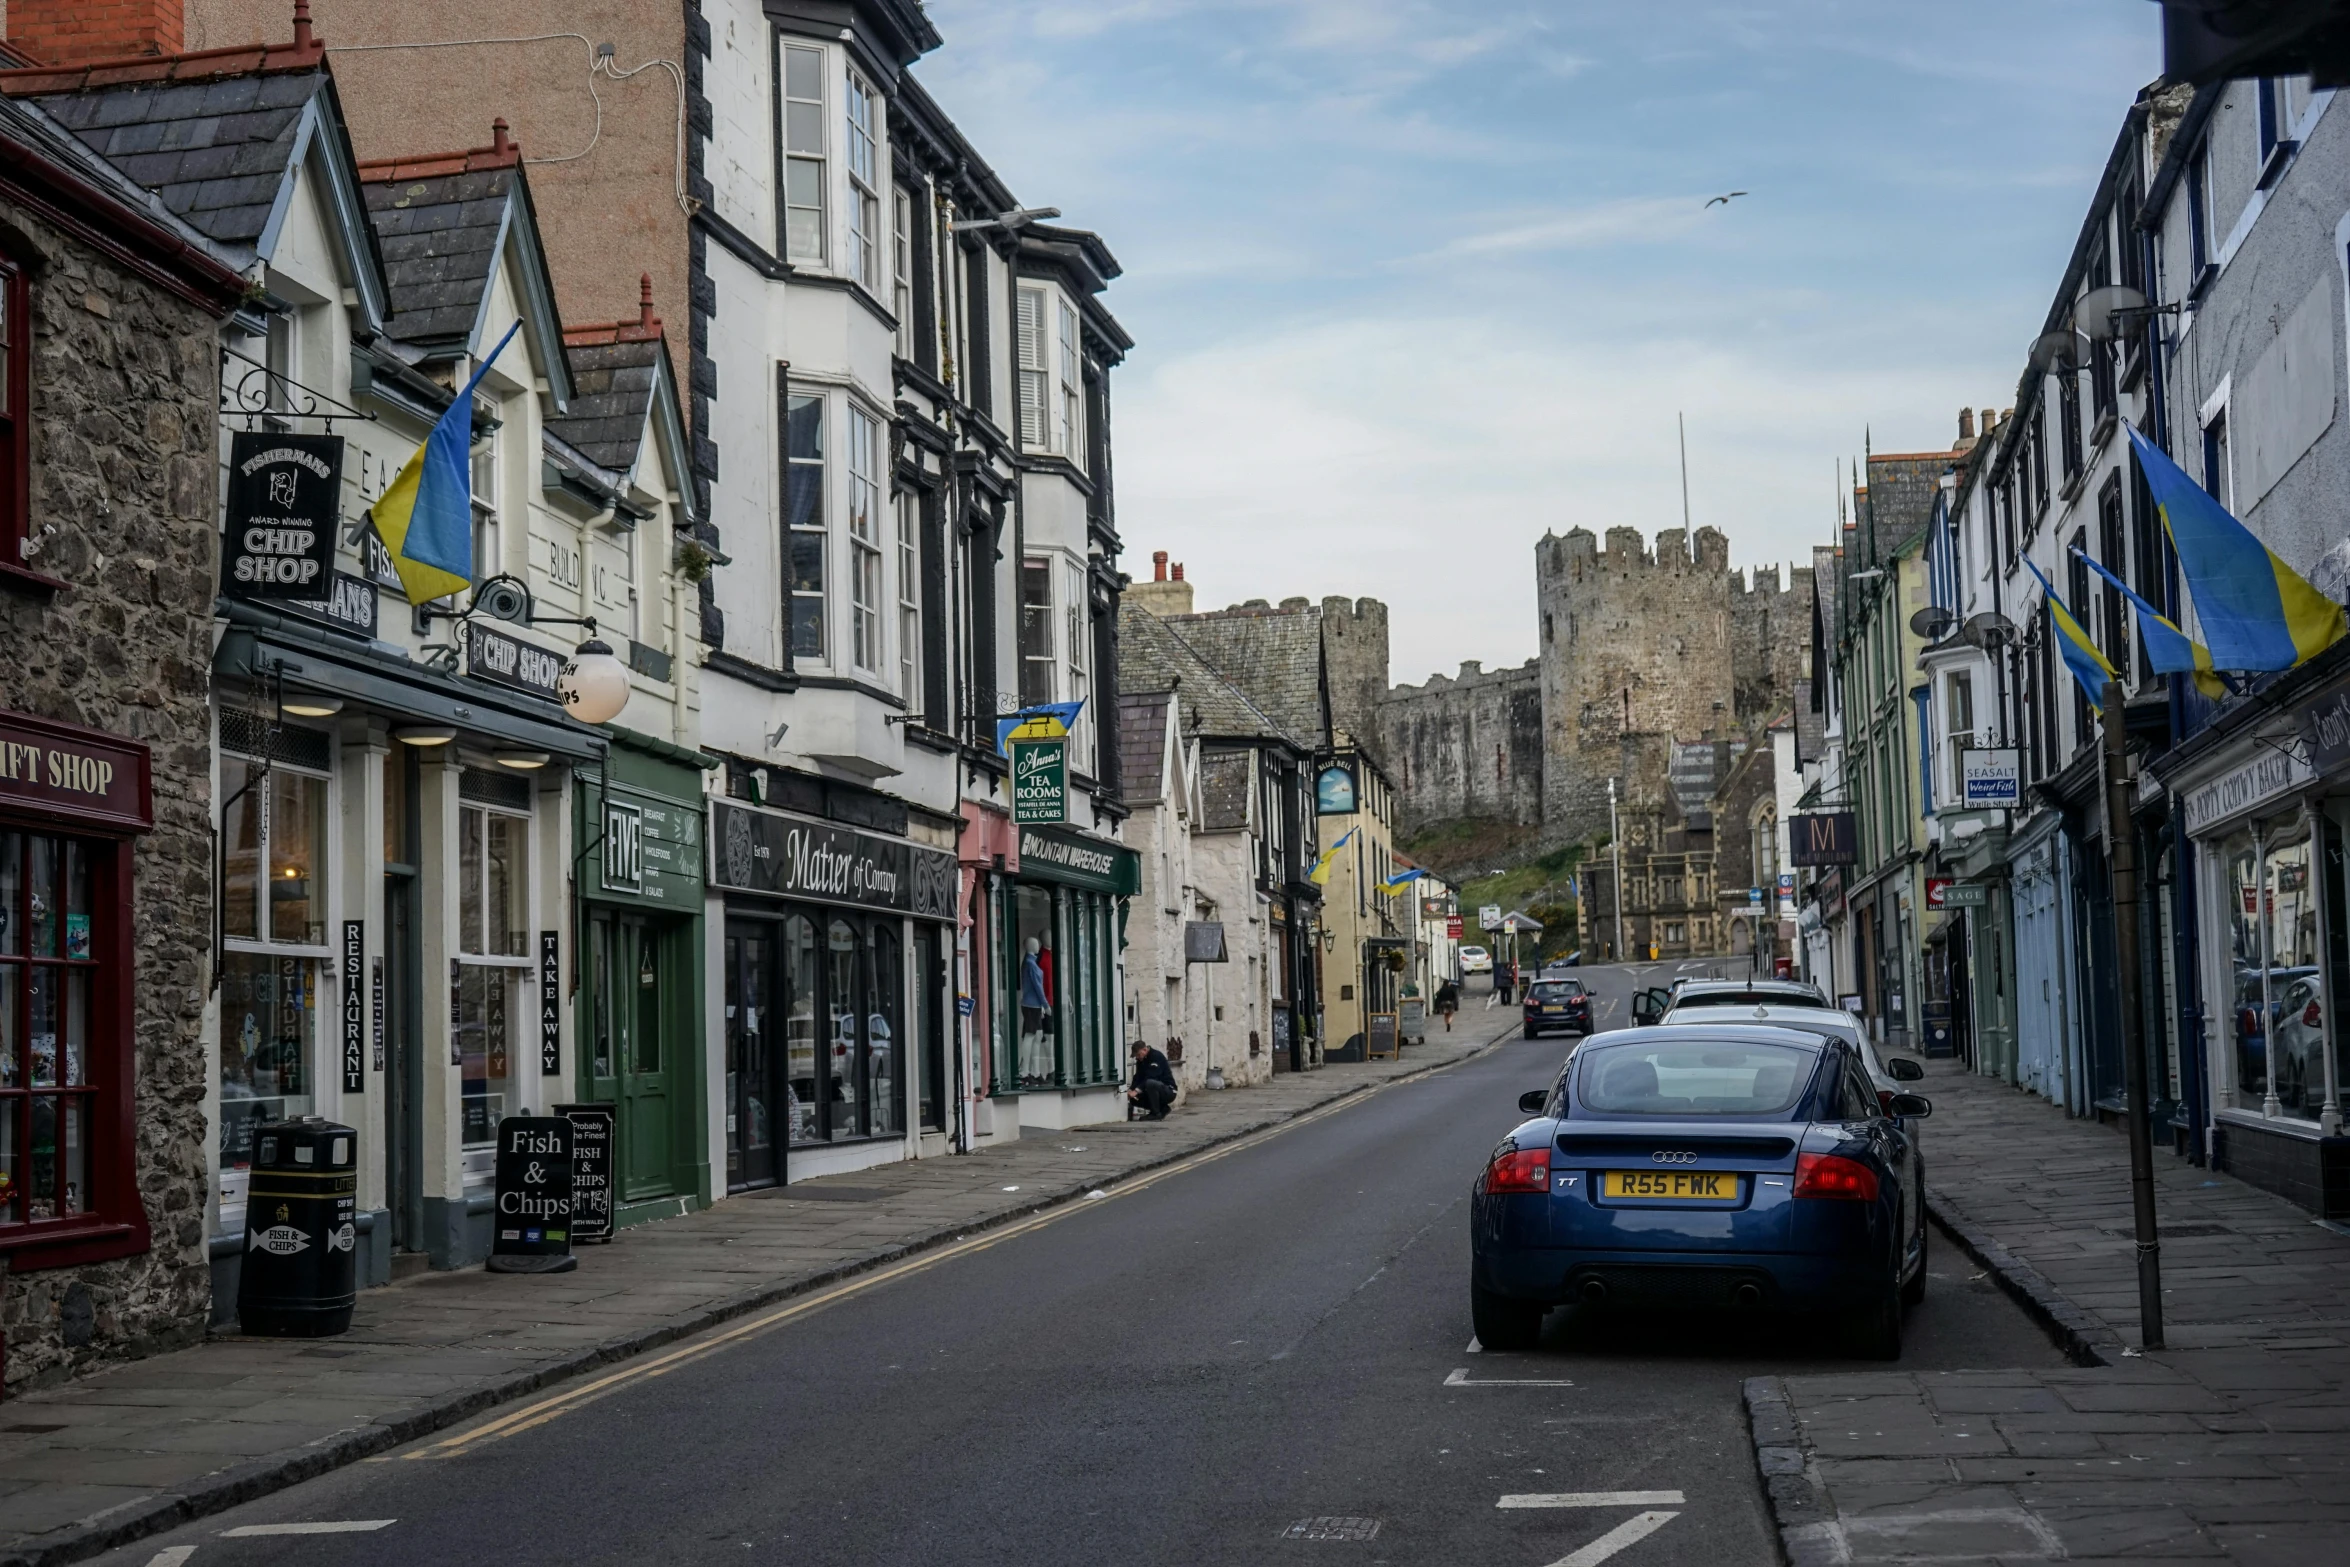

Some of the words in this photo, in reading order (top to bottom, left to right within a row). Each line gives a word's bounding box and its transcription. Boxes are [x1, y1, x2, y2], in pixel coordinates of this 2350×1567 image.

[241, 448, 331, 479] FISHERMANS
[249, 516, 279, 525] AWARD
[282, 516, 313, 527] WINNING
[244, 527, 315, 555] CHIP
[234, 556, 319, 584] SHOP
[484, 634, 517, 675] CHIP
[519, 647, 560, 690] SHOP
[1017, 747, 1061, 775] Anna's
[1317, 760, 1335, 771] BLUE
[1336, 760, 1352, 771] BELL
[48, 749, 113, 796] SHOP
[1967, 767, 2015, 778] SEASALT
[1029, 775, 1050, 787] TEA
[1969, 780, 1996, 792] Weird
[1996, 779, 2014, 791] Fish
[1017, 786, 1061, 799] ROOMS
[2196, 782, 2220, 824] POPTY
[2222, 765, 2255, 812] CONWY
[1017, 811, 1031, 819] TEA
[1032, 810, 1038, 818] &
[1039, 810, 1061, 818] CAKES
[1811, 817, 1835, 852] M
[608, 811, 640, 881] FIVE
[1028, 835, 1070, 864] MOUNTAIN
[1069, 846, 1114, 875] WAREHOUSE
[1795, 853, 1811, 864] THE
[1814, 850, 1853, 863] MIDLAND
[786, 828, 852, 895] Matier
[853, 857, 864, 898] of
[865, 859, 897, 904] Conwy
[1947, 890, 1982, 901] SAGE
[346, 924, 361, 1089] RESTAURANT
[573, 1122, 603, 1131] Probably
[509, 1130, 562, 1154] Fish
[584, 1131, 606, 1139] Finest
[573, 1147, 601, 1159] FISH
[523, 1161, 547, 1184] &
[581, 1161, 592, 1173] &
[1557, 1177, 1578, 1188] TT
[1621, 1172, 1667, 1195] R55
[1673, 1172, 1719, 1195] FWK
[582, 1191, 589, 1199] in
[499, 1191, 570, 1221] Chips
[268, 1230, 290, 1240] FISH
[291, 1230, 299, 1240] &
[268, 1241, 297, 1251] CHIPS
